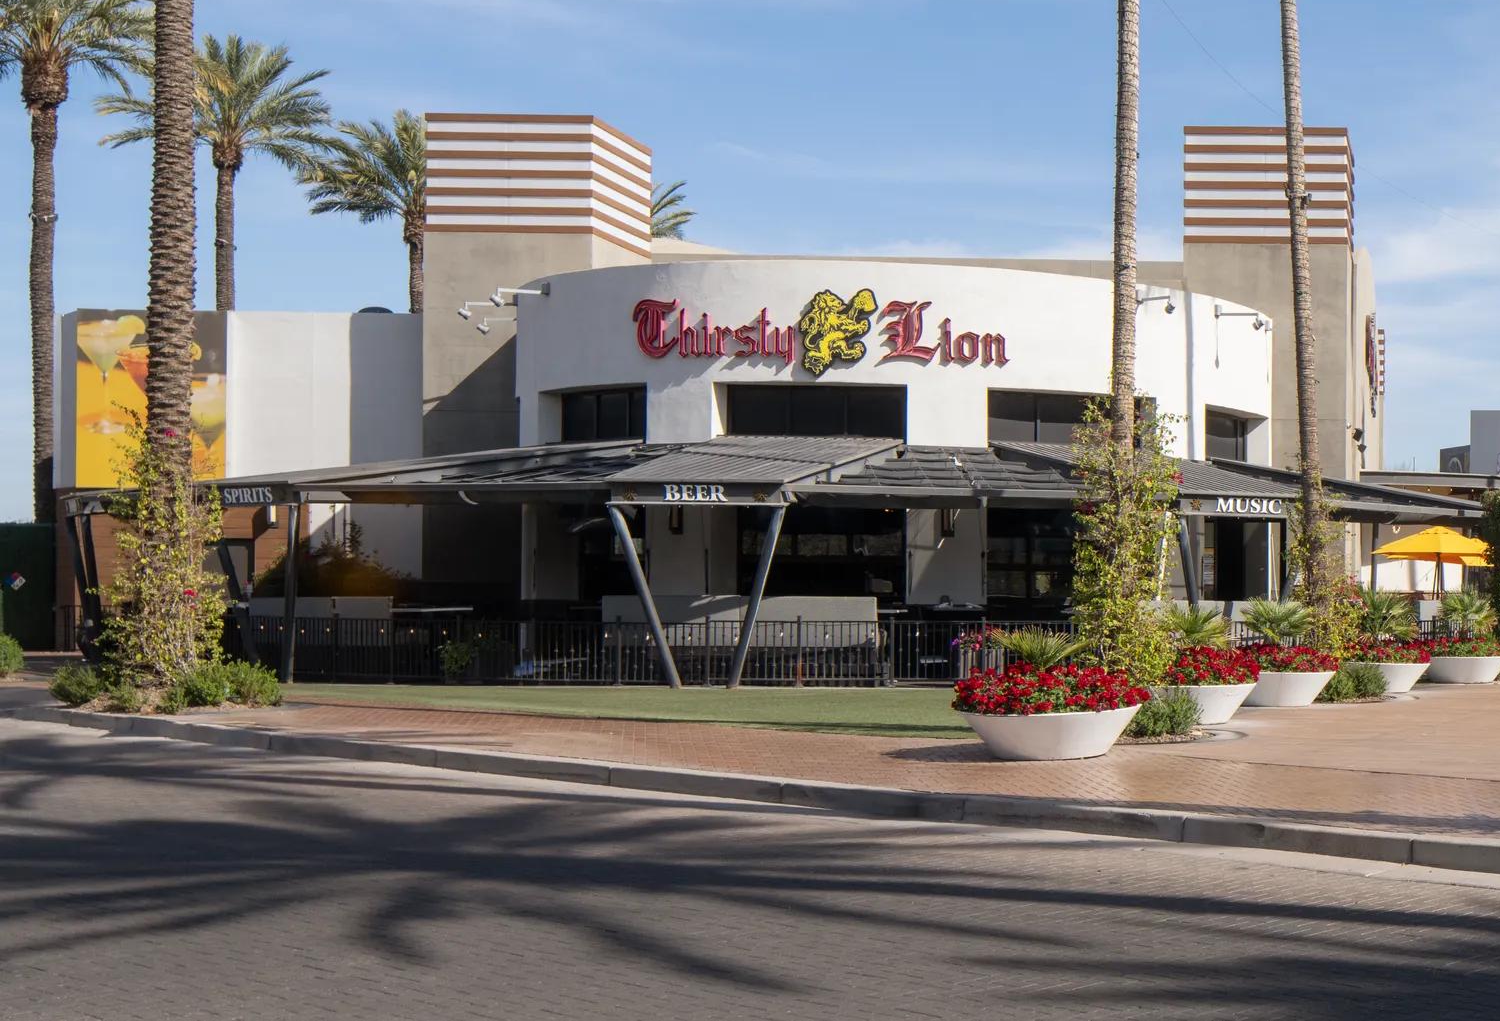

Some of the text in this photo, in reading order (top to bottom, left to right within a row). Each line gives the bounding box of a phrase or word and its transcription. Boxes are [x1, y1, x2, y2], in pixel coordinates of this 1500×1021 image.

[632, 298, 1010, 364] Thirsty Lion
[224, 487, 273, 504] SPIRITS
[663, 484, 729, 502] BEER
[1215, 497, 1282, 514] MUSIC
